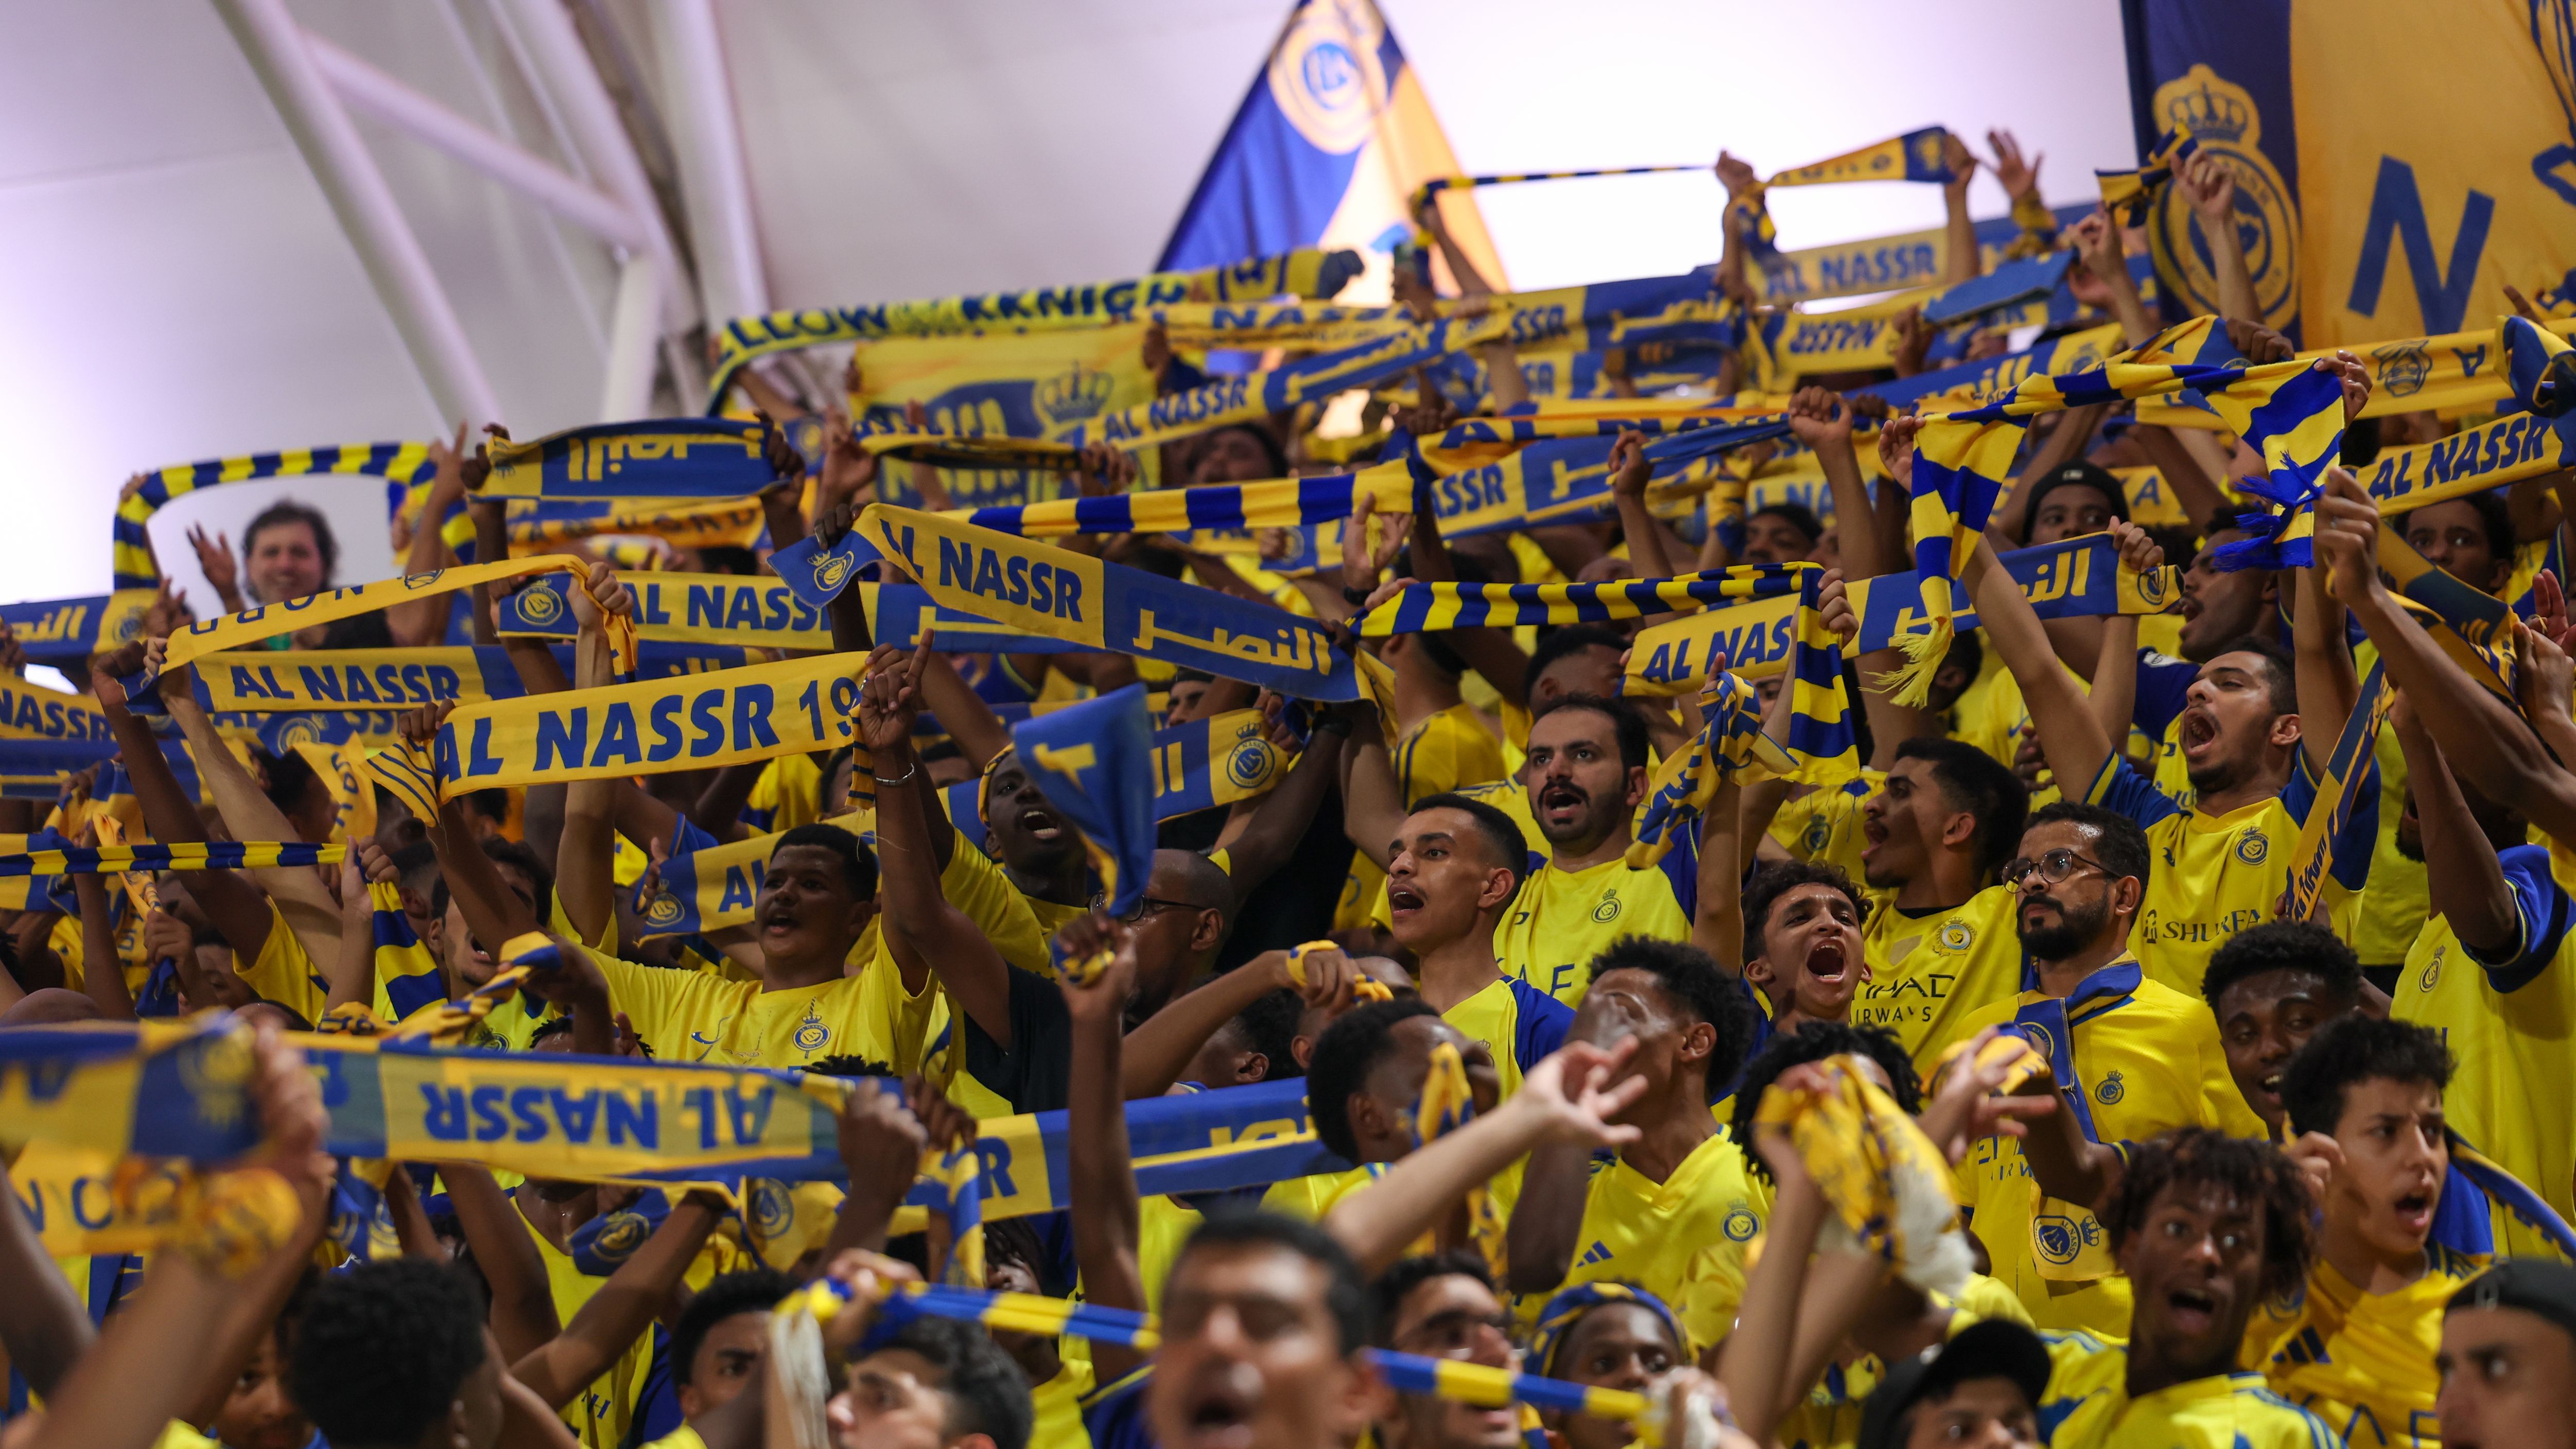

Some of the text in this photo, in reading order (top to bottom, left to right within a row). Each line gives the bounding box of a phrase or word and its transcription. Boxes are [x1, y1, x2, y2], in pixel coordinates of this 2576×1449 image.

[1434, 466, 1506, 514] SSR
[2369, 415, 2552, 501] AL NASSR
[939, 535, 1083, 623] NASSR
[11, 605, 88, 642] النص
[1133, 607, 1332, 676] النصر
[1641, 615, 1791, 684] AL NAS
[230, 664, 461, 703] AL NASSR
[433, 717, 504, 784] AL
[533, 683, 781, 772] NASSR
[419, 1083, 775, 1150] AL NASSR
[2066, 1228, 2080, 1258] NASSR
